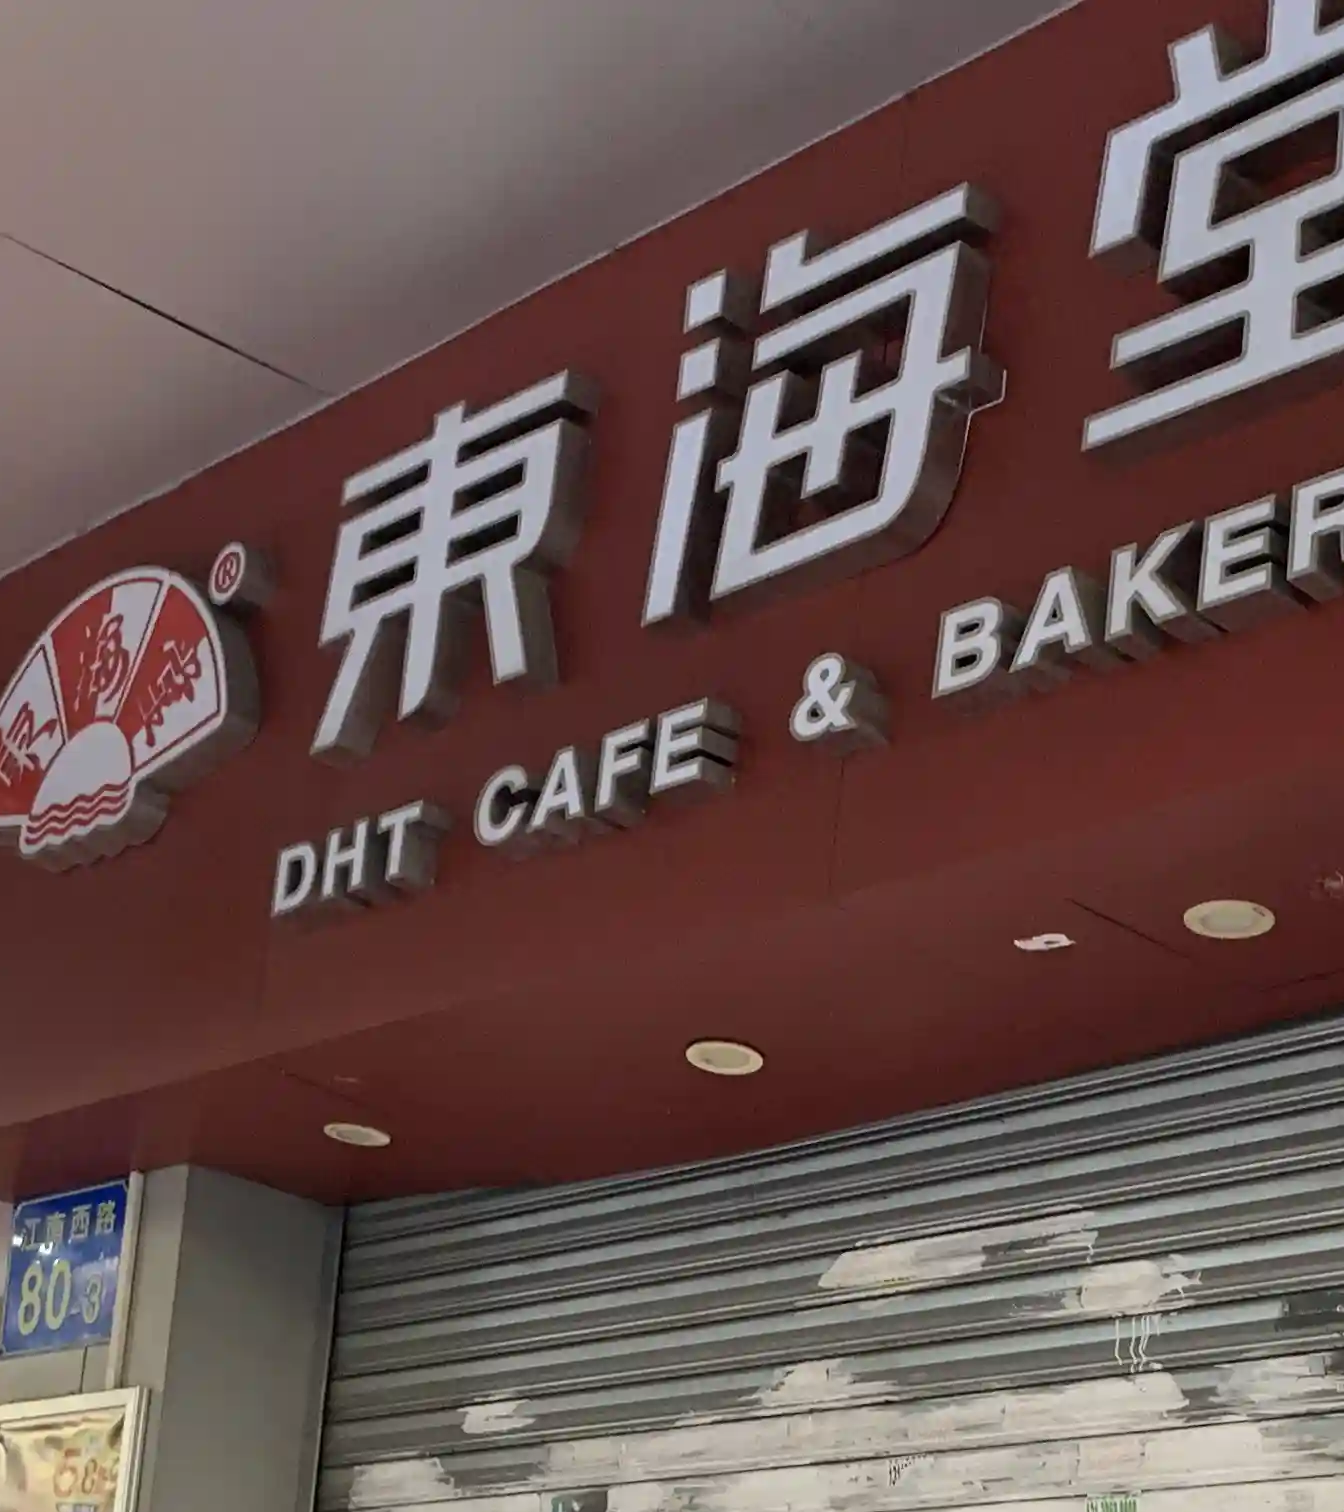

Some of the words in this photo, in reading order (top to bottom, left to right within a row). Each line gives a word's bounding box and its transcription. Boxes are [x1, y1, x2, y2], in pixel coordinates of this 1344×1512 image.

[270, 804, 426, 917] DHT
[473, 698, 712, 847] CAFE
[789, 651, 858, 742] &
[21, 1200, 117, 1253] 江南西路
[18, 1259, 103, 1336] 80-3
